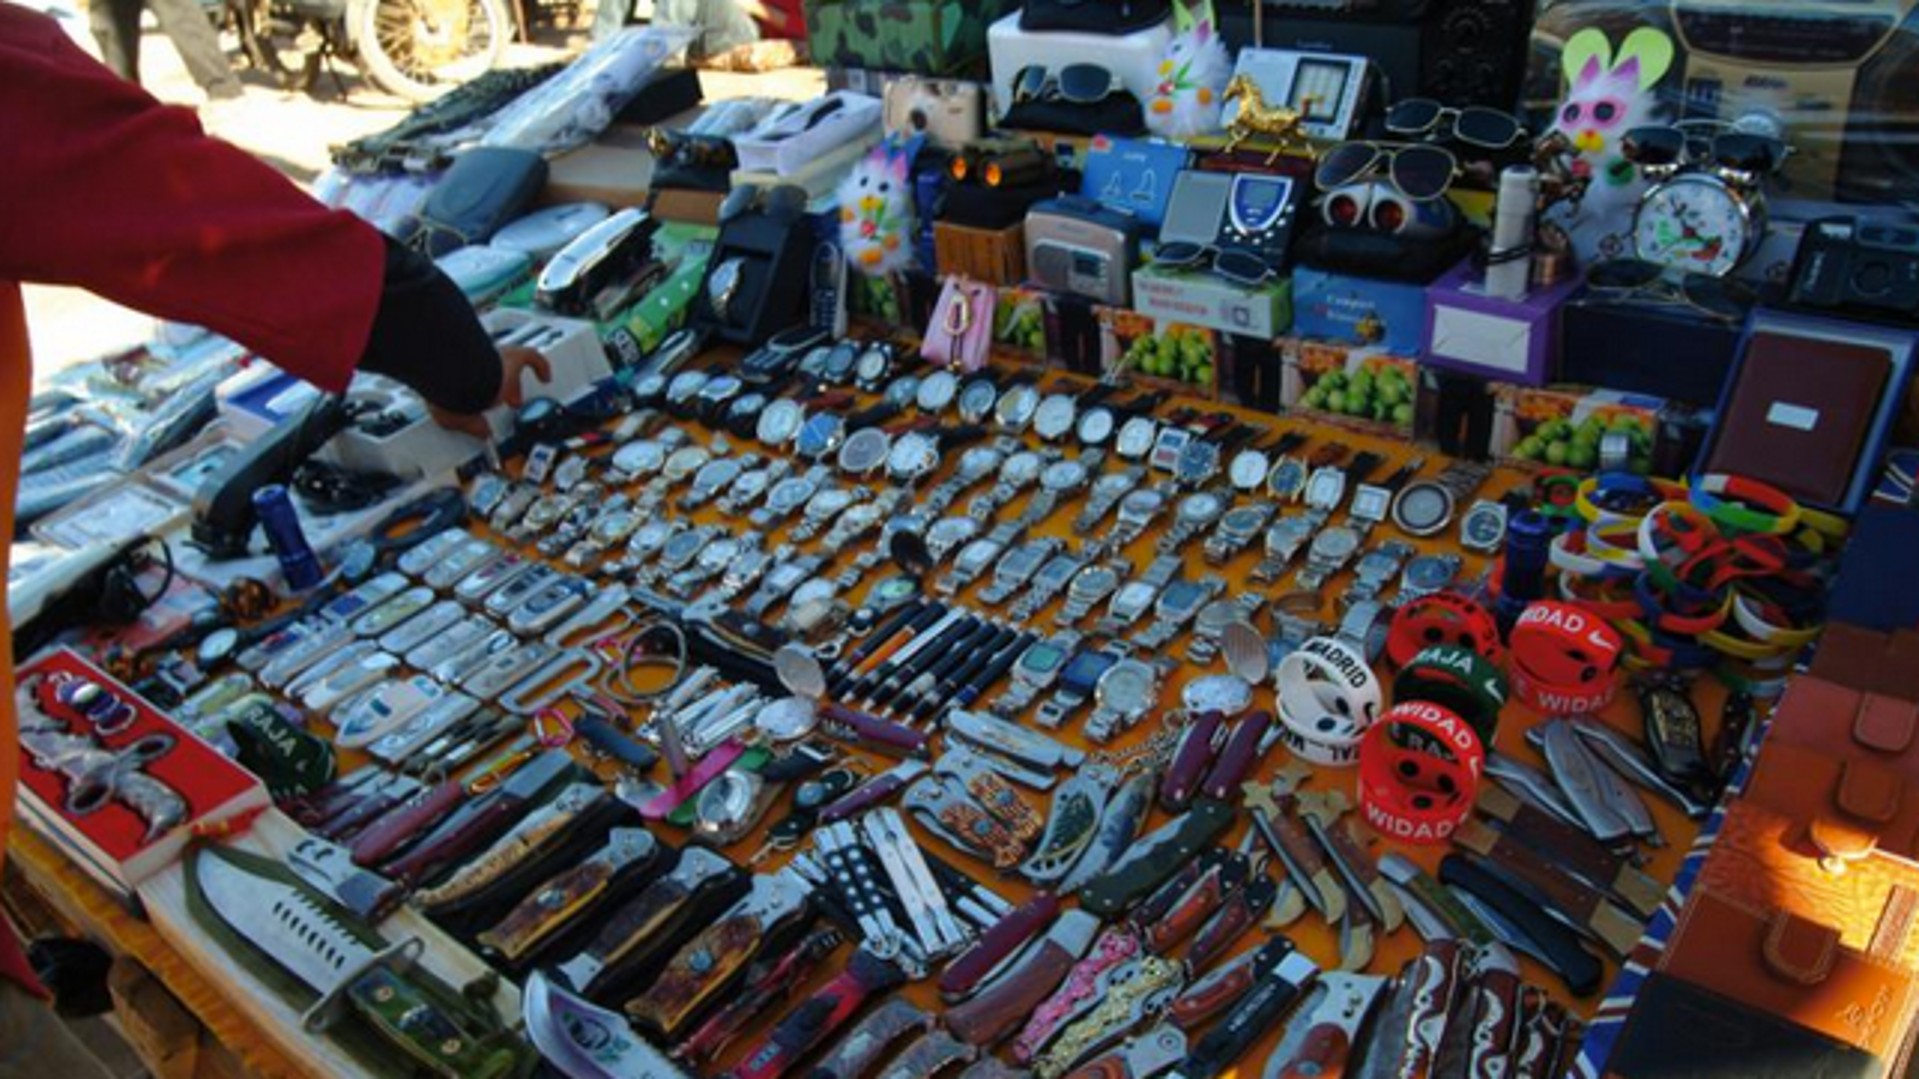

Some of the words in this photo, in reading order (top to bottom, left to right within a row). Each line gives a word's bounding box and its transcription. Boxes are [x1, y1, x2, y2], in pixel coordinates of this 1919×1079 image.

[246, 704, 297, 757] RAJA
[1391, 702, 1473, 750] WIDAD
[1365, 801, 1455, 838] WIDAD
